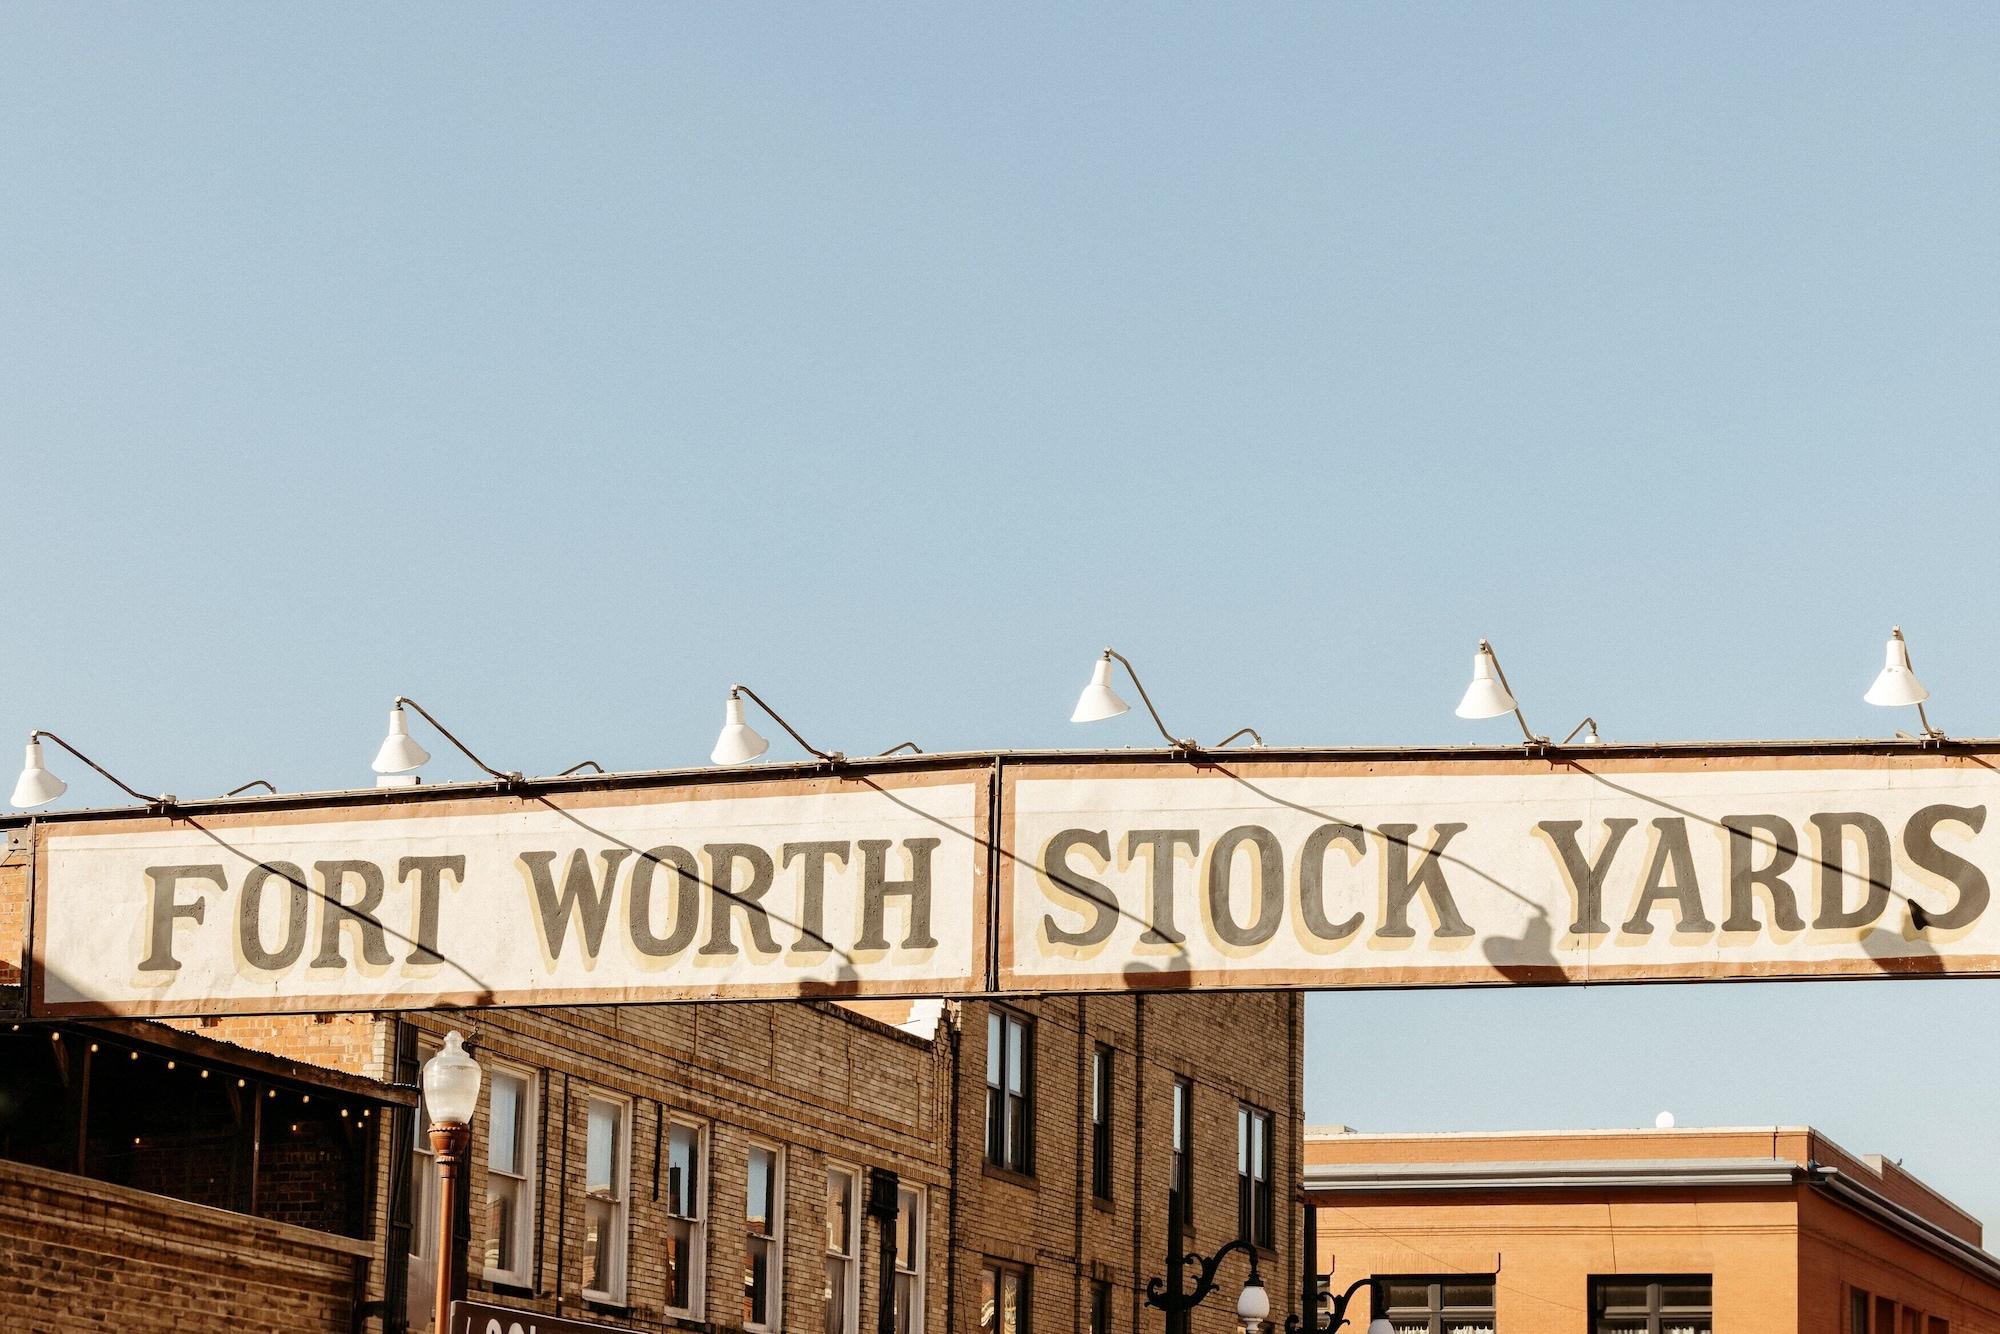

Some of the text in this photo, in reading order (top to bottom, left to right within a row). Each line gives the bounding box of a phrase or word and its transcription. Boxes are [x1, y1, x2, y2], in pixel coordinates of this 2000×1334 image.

[137, 803, 1991, 972] FORT WORTH STOCK YARDS
